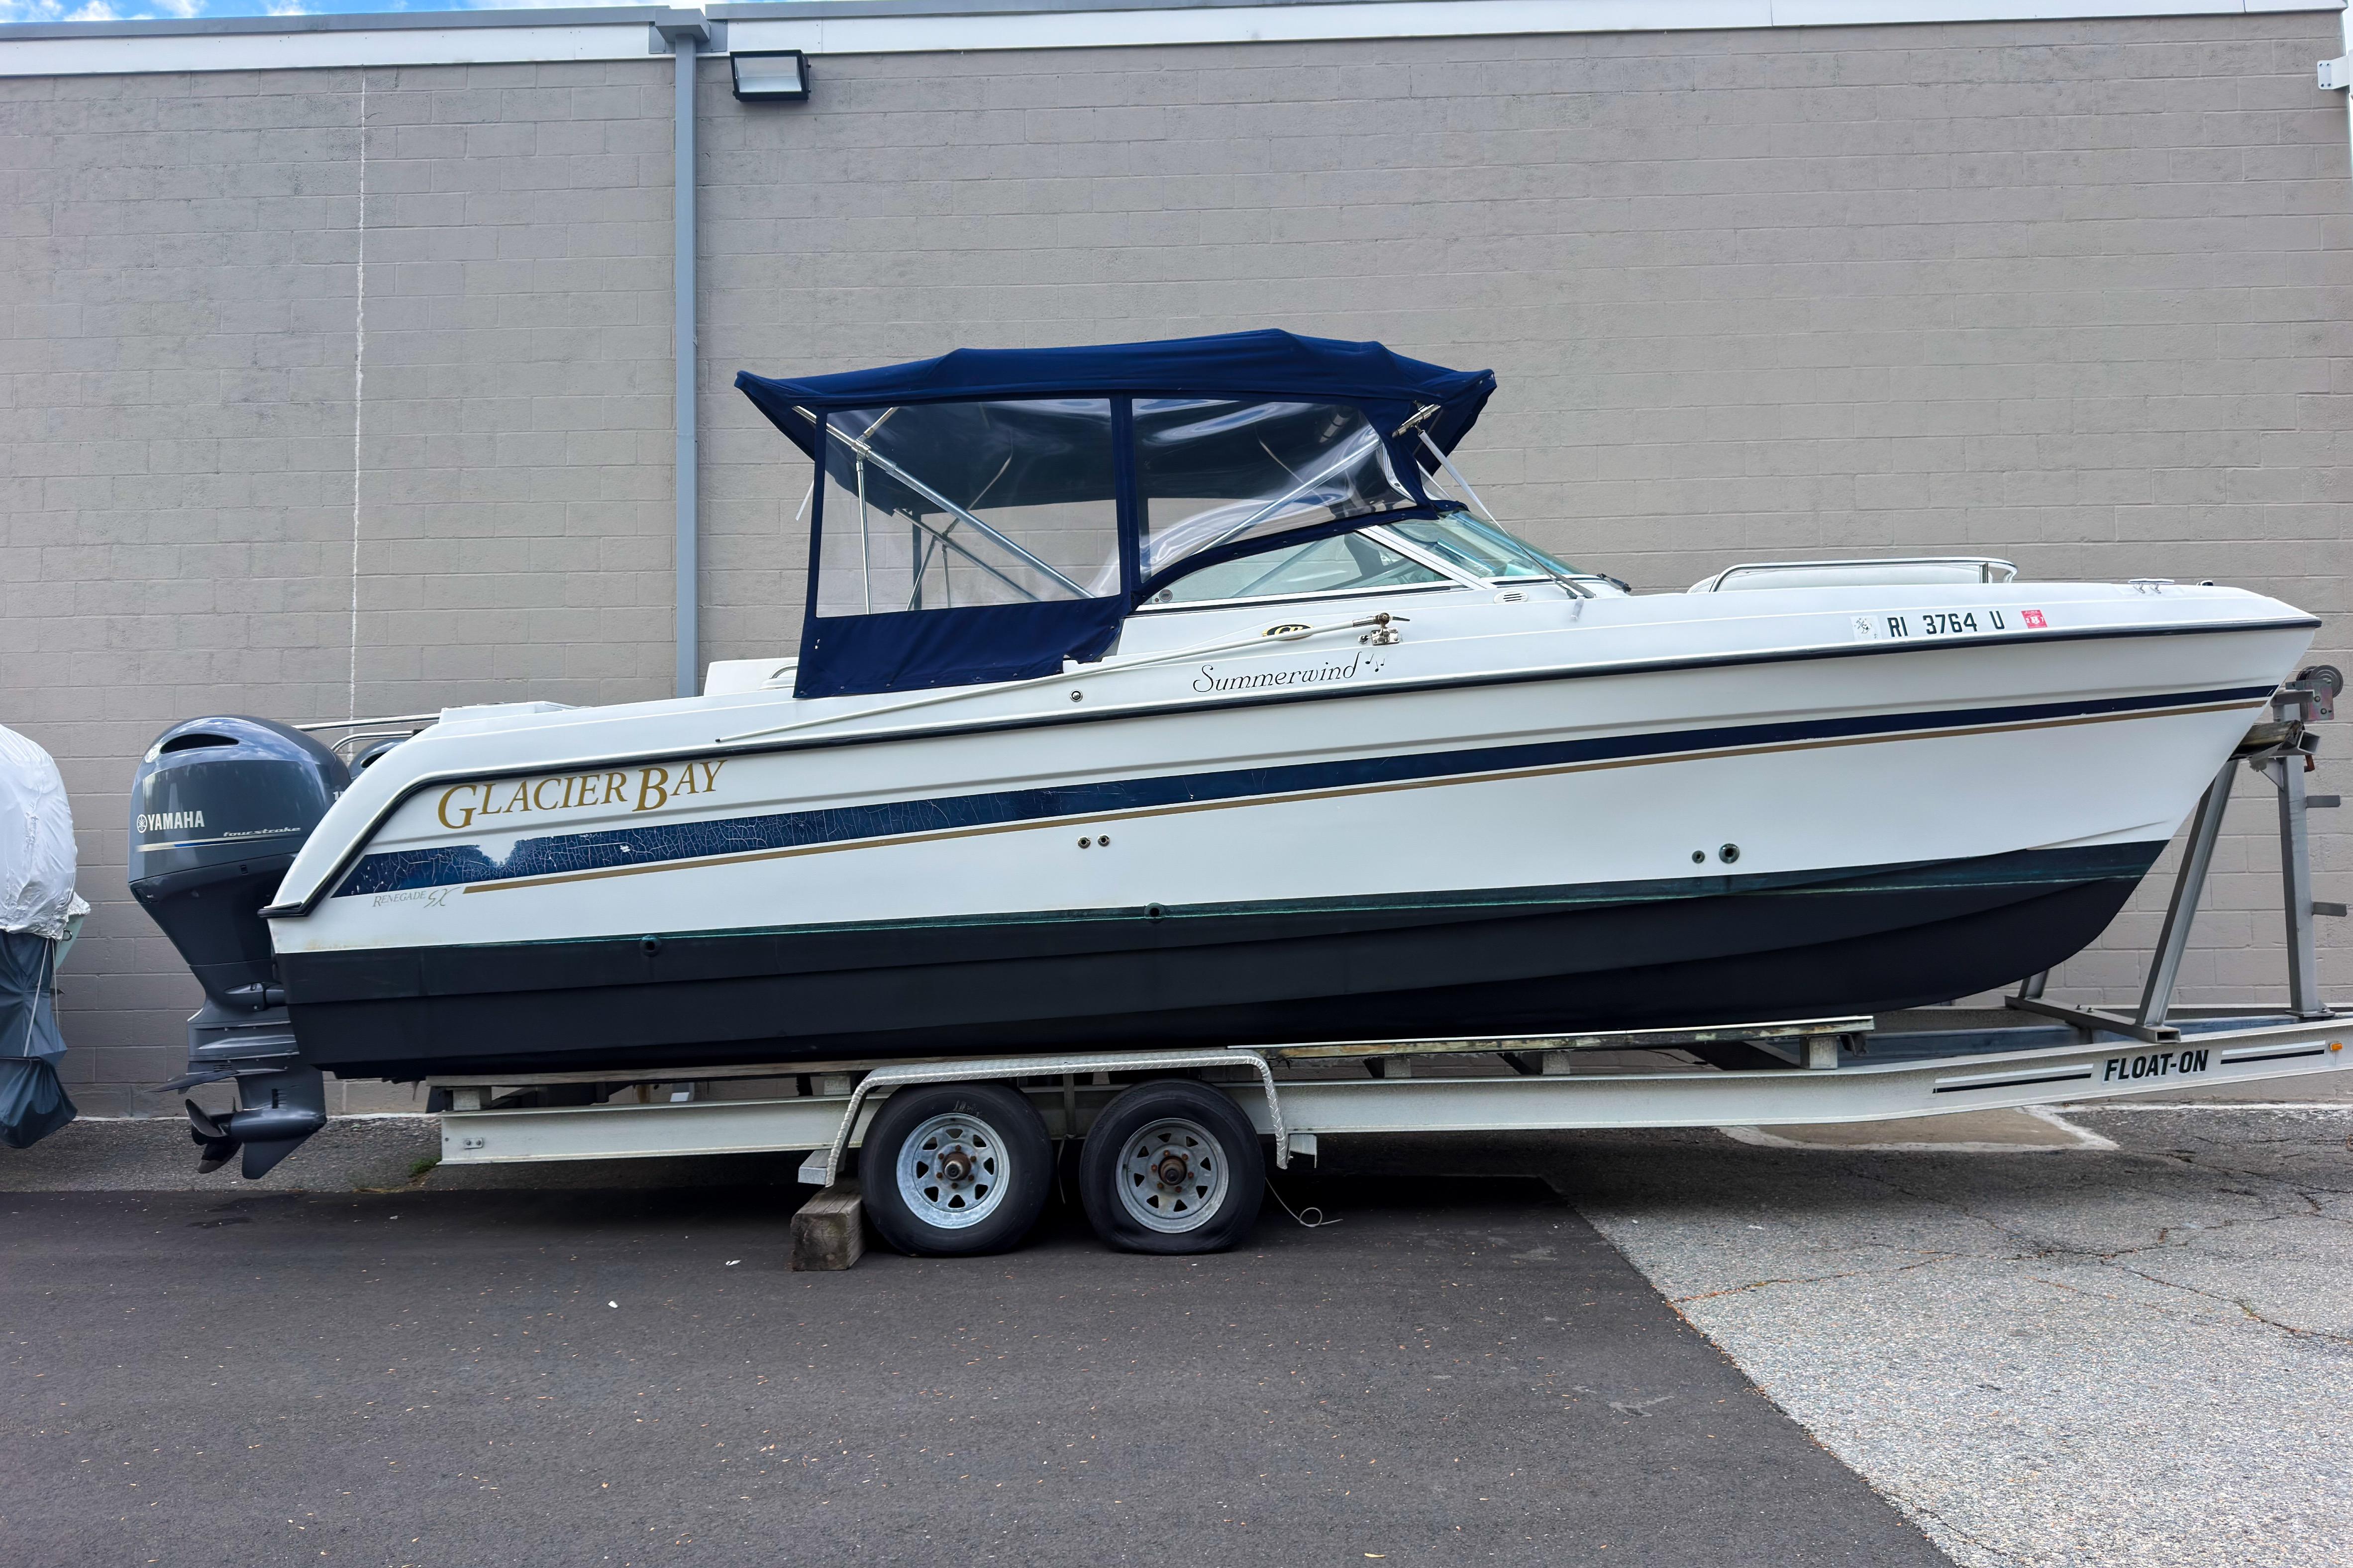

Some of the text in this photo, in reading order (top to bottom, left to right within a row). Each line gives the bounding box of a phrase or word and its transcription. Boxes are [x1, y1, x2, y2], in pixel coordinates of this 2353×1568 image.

[1887, 616, 1909, 637] RI
[1923, 612, 1977, 635] 3764
[1989, 610, 2005, 630] U
[1192, 651, 1362, 693] Summerwind
[437, 759, 728, 829] GLACIER BAY
[147, 810, 205, 831] YAMAHA
[372, 887, 461, 908] RENEGADE SX
[2104, 1049, 2209, 1081] FLOAT-ON
